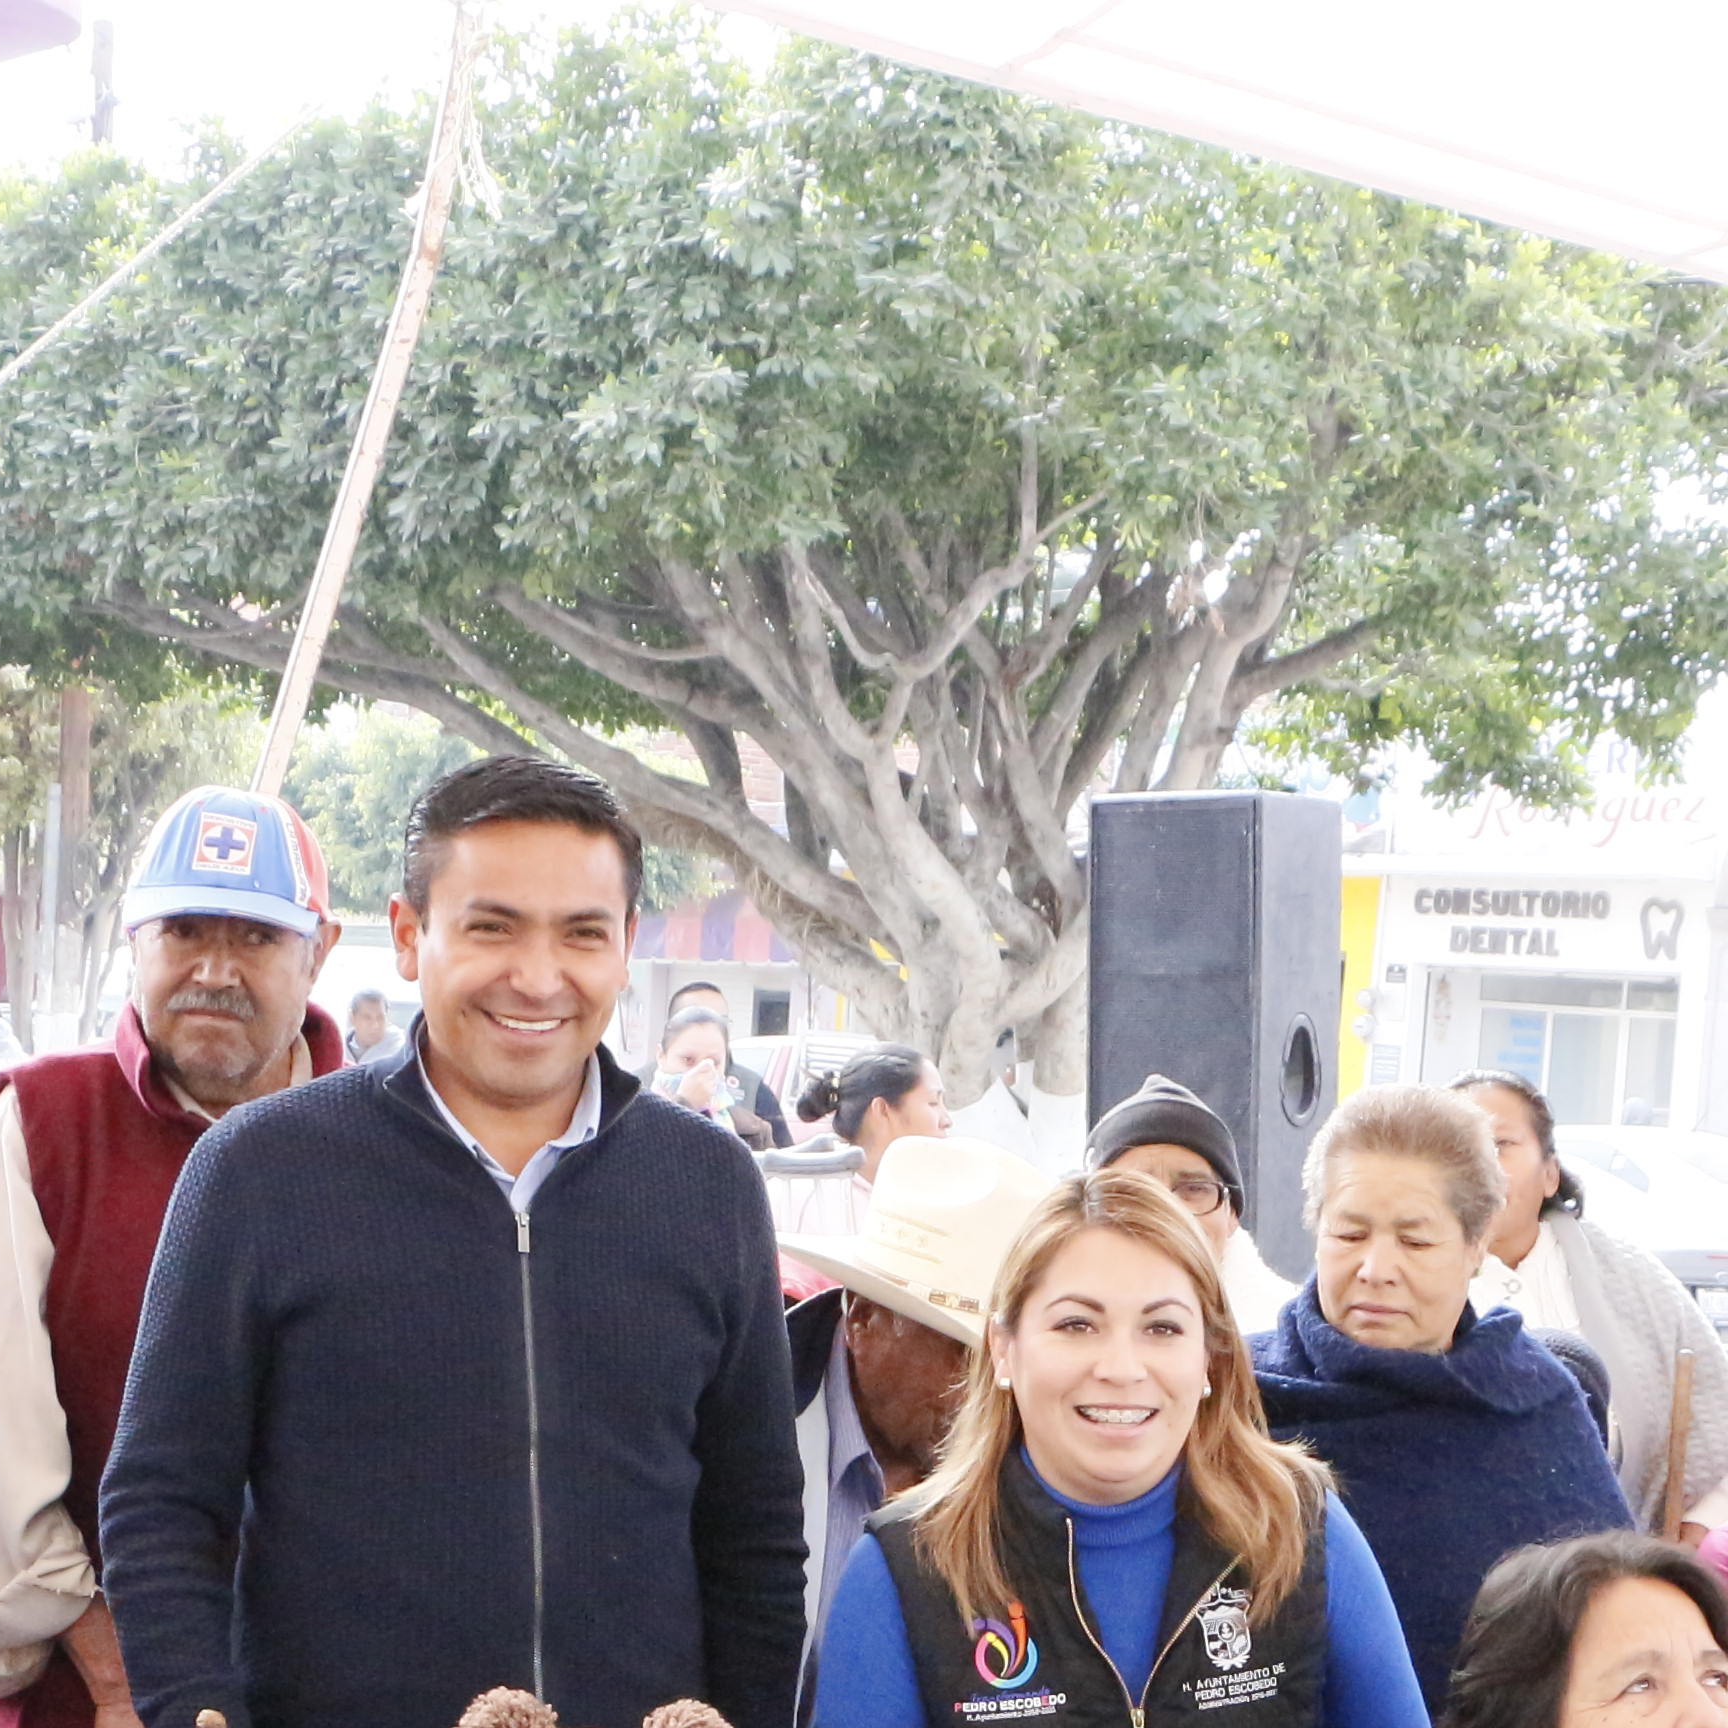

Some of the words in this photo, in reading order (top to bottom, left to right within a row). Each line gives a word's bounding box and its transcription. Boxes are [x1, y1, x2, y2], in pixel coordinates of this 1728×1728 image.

[1414, 886, 1613, 919] CONSULTORIO
[1449, 925, 1560, 957] DENTAL
[1194, 1687, 1226, 1701] PEDRO
[1228, 1677, 1277, 1696] ESCOBEDO
[1196, 1667, 1270, 1690] AYUNTAMIENTO
[1272, 1662, 1286, 1675] DE
[954, 1701, 997, 1713] PEDRO
[999, 1693, 1067, 1711] ESCOBEDO
